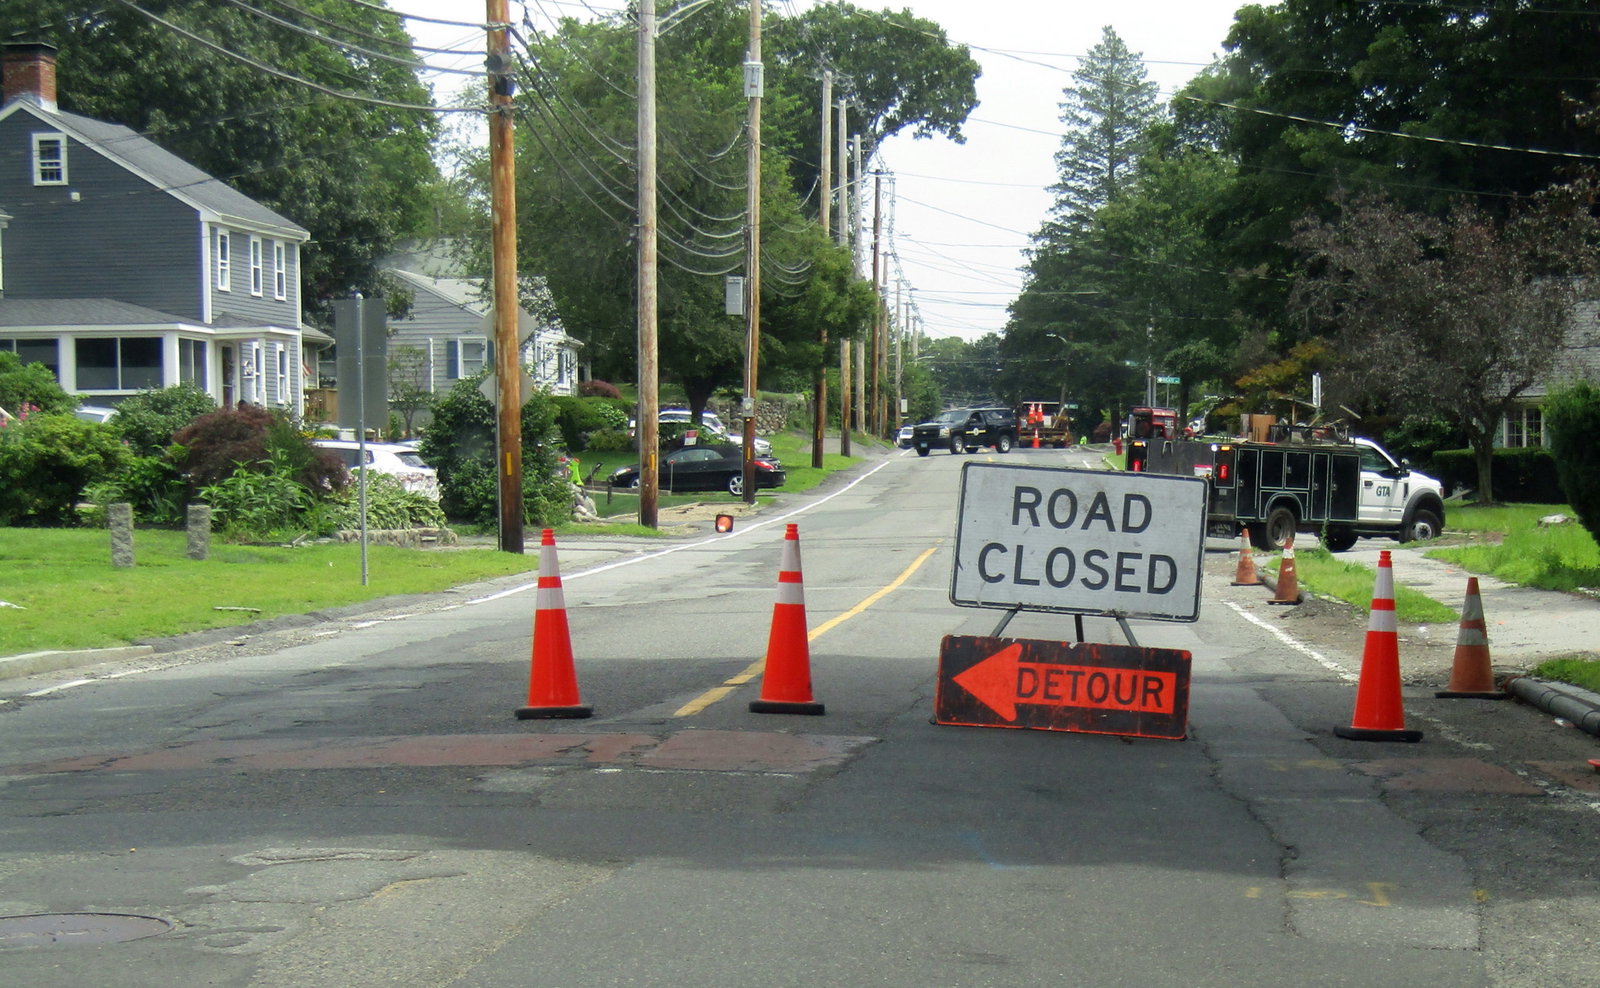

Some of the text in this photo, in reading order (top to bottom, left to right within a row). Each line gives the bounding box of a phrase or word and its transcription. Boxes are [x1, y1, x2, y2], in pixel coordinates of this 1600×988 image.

[1011, 486, 1152, 534] ROAD
[1375, 485, 1391, 497] GTA
[977, 542, 1178, 595] CLOSED
[1016, 667, 1164, 708] DETOUR
